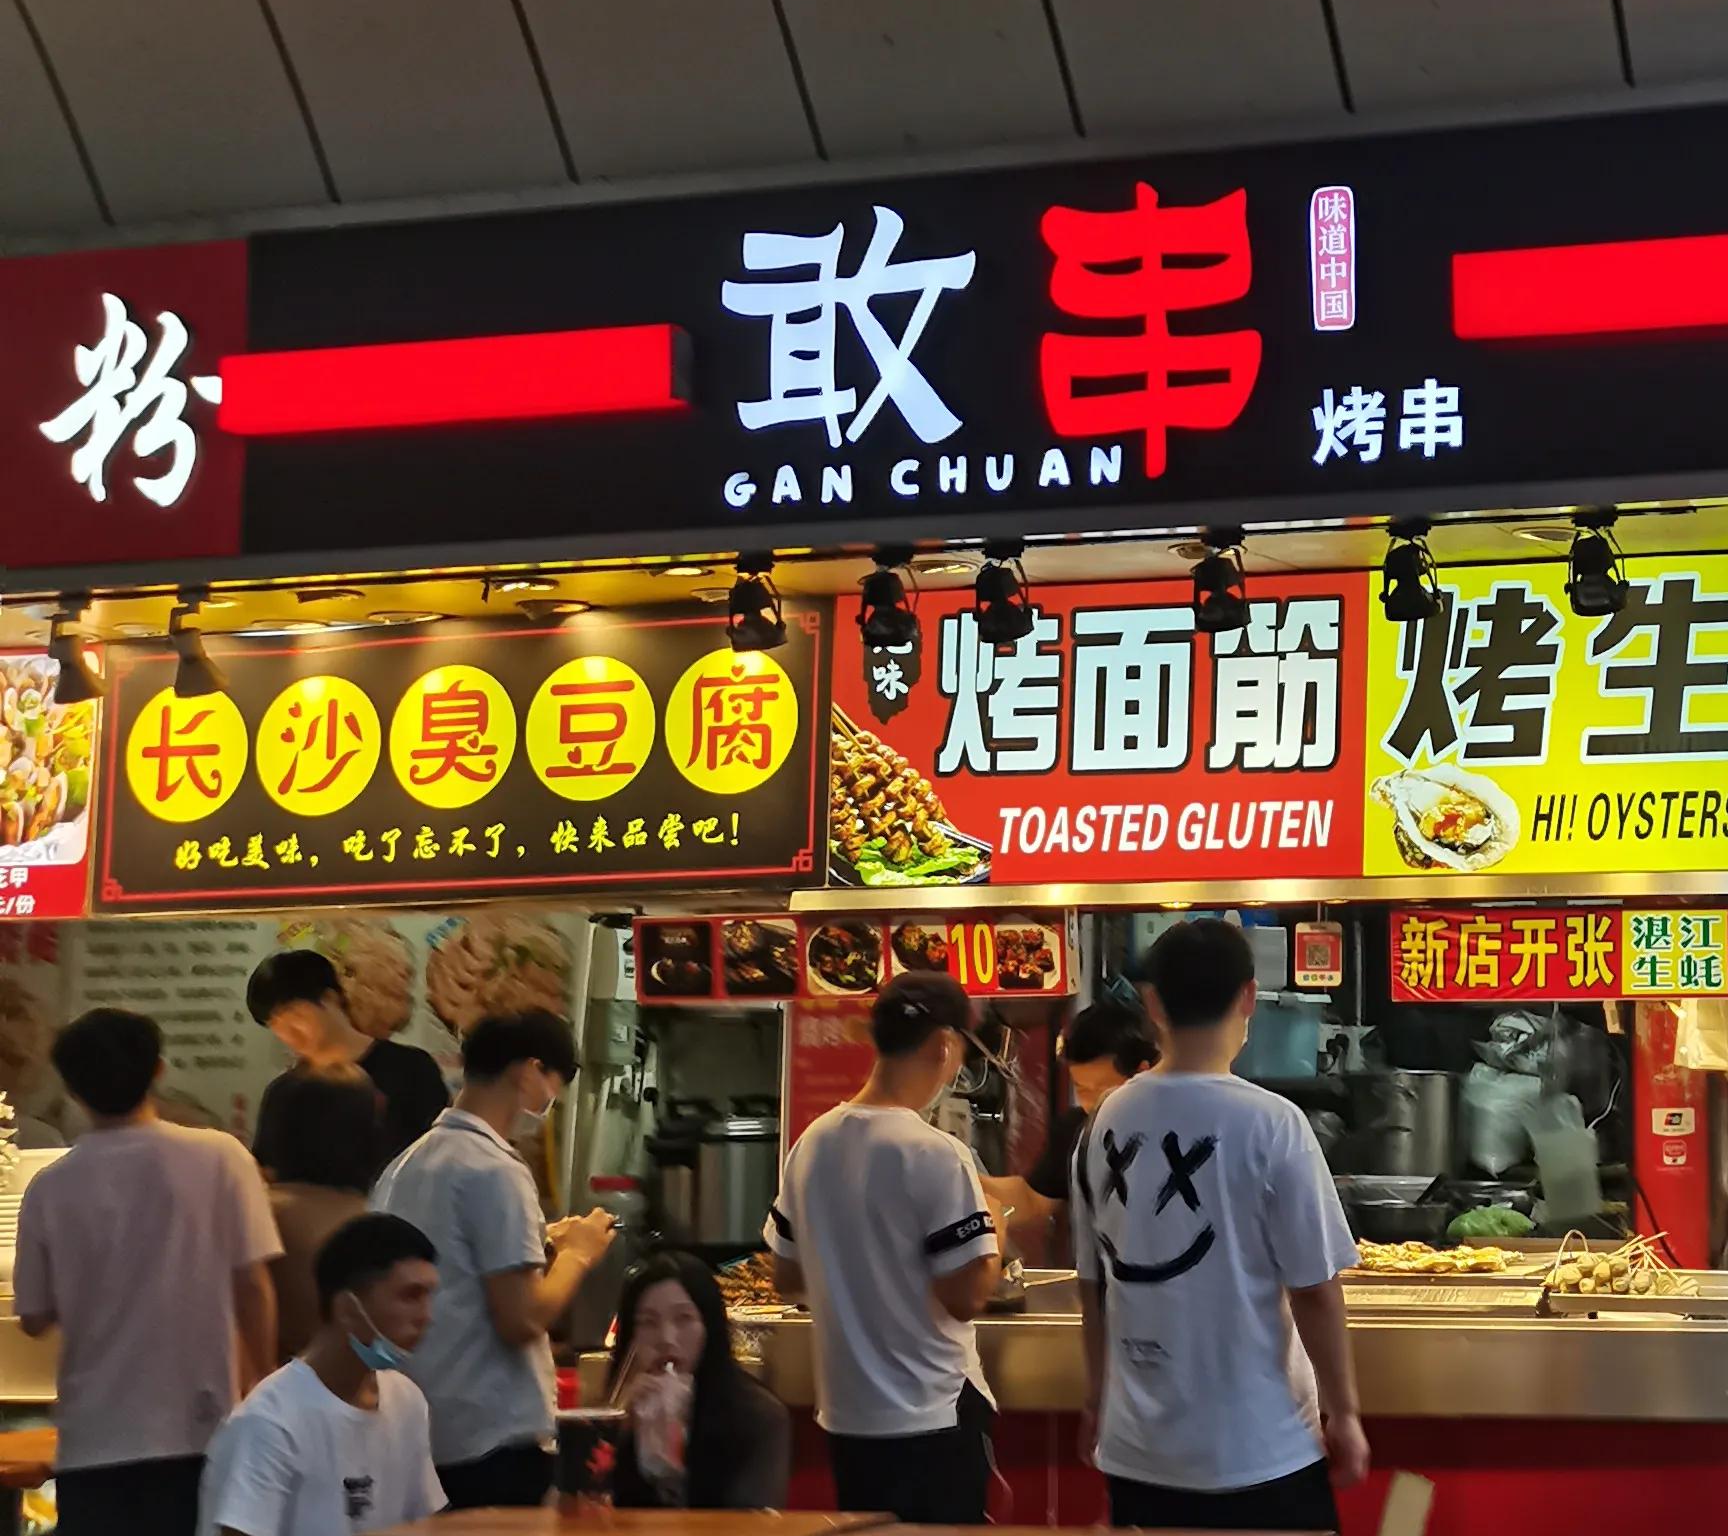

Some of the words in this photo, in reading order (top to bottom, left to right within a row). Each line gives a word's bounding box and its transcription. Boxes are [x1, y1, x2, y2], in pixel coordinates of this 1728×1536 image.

[1316, 190, 1349, 324] 味道中国
[720, 181, 1262, 478] 敢串
[40, 292, 222, 507] 粉
[1310, 377, 1464, 466] 烤串
[723, 464, 853, 508] GAN
[889, 445, 1125, 496] CHUAN
[938, 600, 1340, 772] 烤面筋
[142, 667, 779, 800] 长沙臭豆腐
[999, 803, 1170, 855] TOASTED
[1177, 800, 1334, 850] GLUTEN
[1531, 794, 1573, 842] HI!
[949, 922, 994, 985] 10
[1400, 913, 1614, 991] 新店开张
[1631, 914, 1723, 950] 湛江
[1631, 953, 1723, 990] 生蚝
